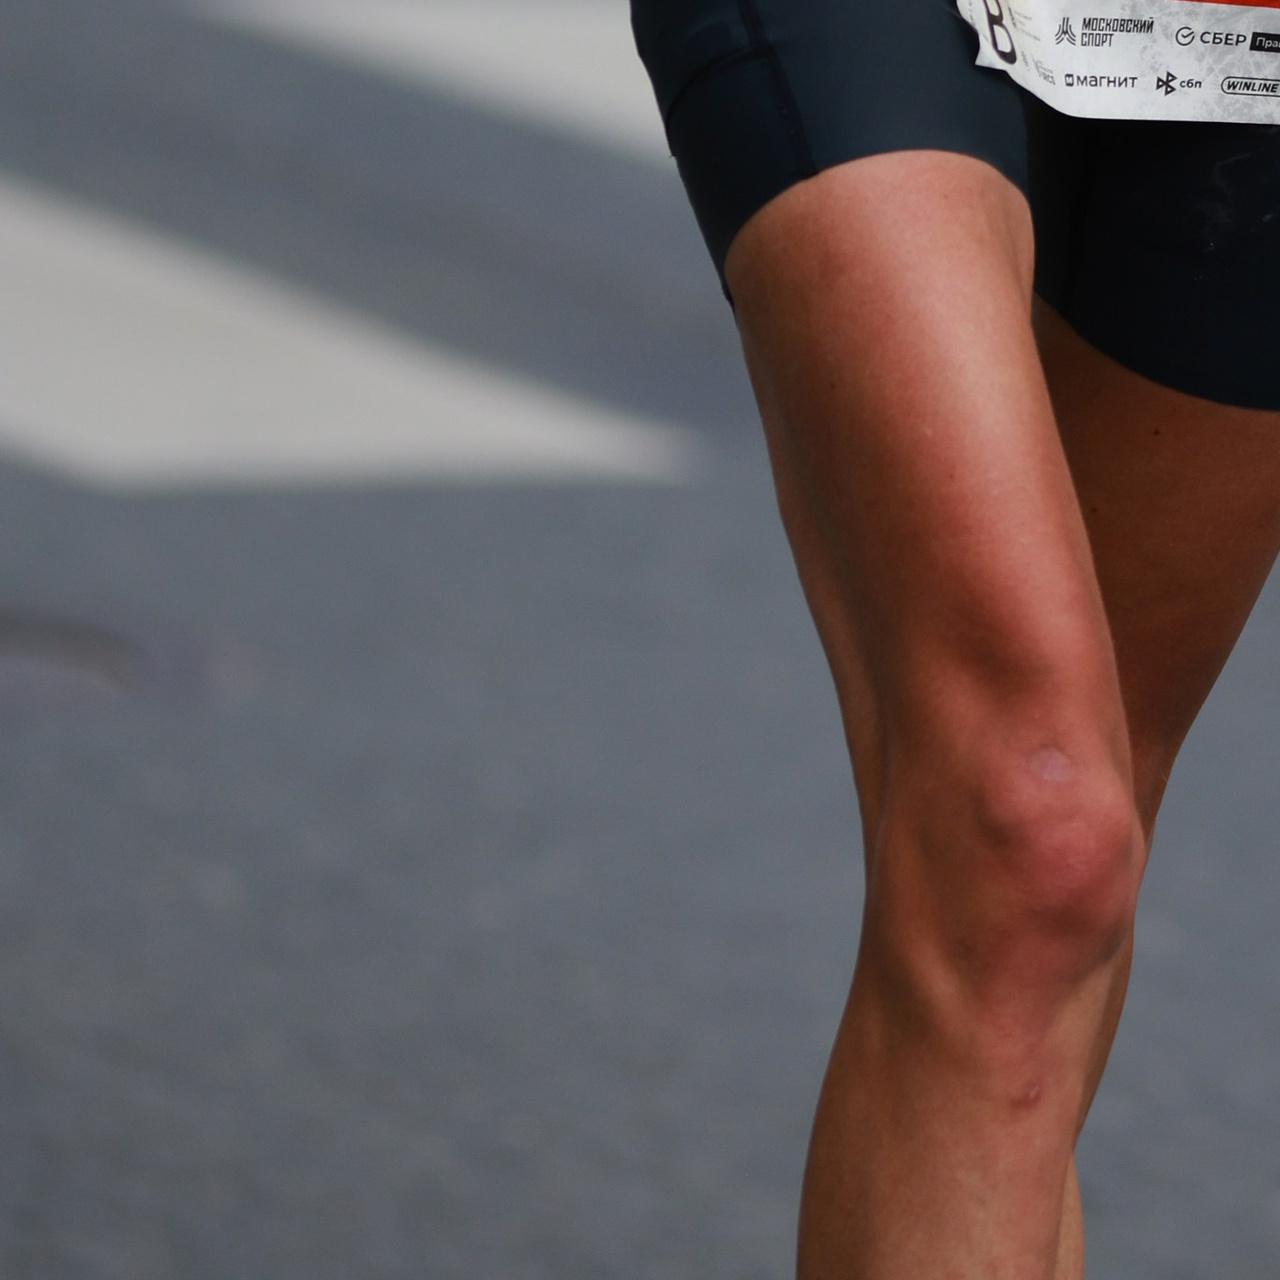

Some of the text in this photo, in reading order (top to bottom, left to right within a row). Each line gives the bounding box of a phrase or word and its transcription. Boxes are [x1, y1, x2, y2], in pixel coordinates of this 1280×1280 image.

[1081, 17, 1154, 33] МОСКОВСКИЙ
[1080, 32, 1114, 47] СПОРТ
[1200, 31, 1247, 46] СБЕР
[1226, 80, 1279, 93] WINLINE
